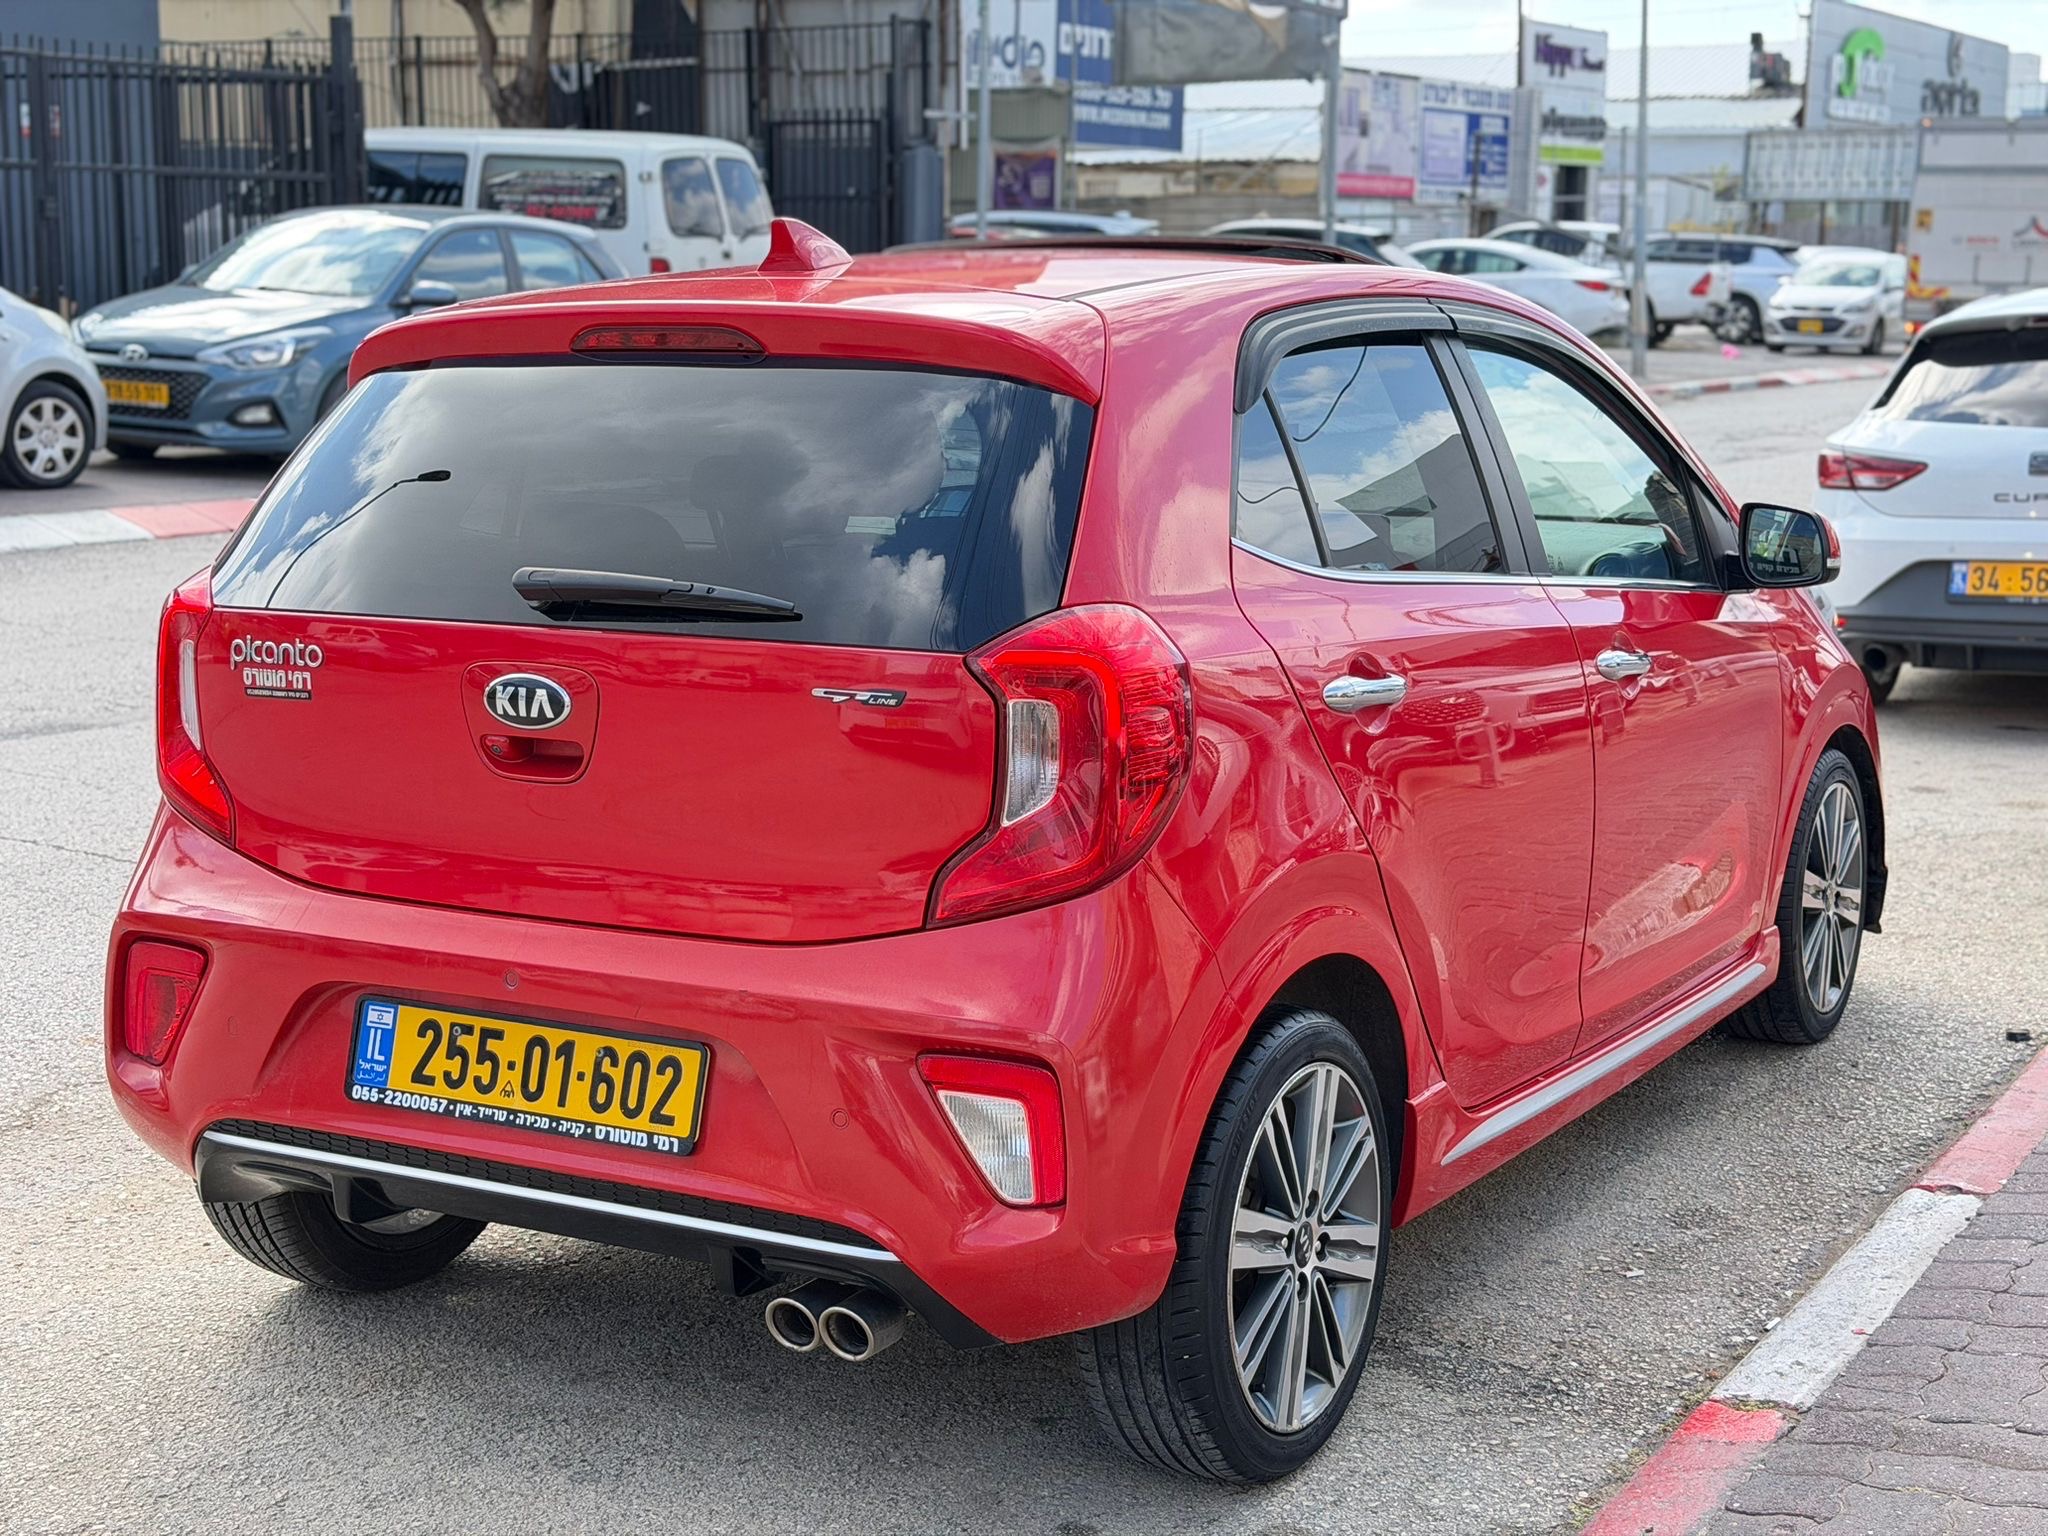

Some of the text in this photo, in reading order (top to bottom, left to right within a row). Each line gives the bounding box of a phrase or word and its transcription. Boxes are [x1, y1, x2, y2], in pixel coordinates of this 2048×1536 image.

[230, 634, 323, 670] picanto
[243, 667, 312, 690] רמי מוטורס
[495, 685, 555, 719] KIA
[868, 697, 898, 706] LINE
[366, 1028, 385, 1061] IL
[358, 1059, 387, 1073] ישראל
[351, 1084, 448, 1113] 055-2200057
[455, 1103, 507, 1122] טרייד-אין
[516, 1113, 550, 1129] מכירה
[558, 1121, 585, 1138] קניה
[595, 1125, 648, 1148] מוטורס
[653, 1135, 679, 1153] רמי
